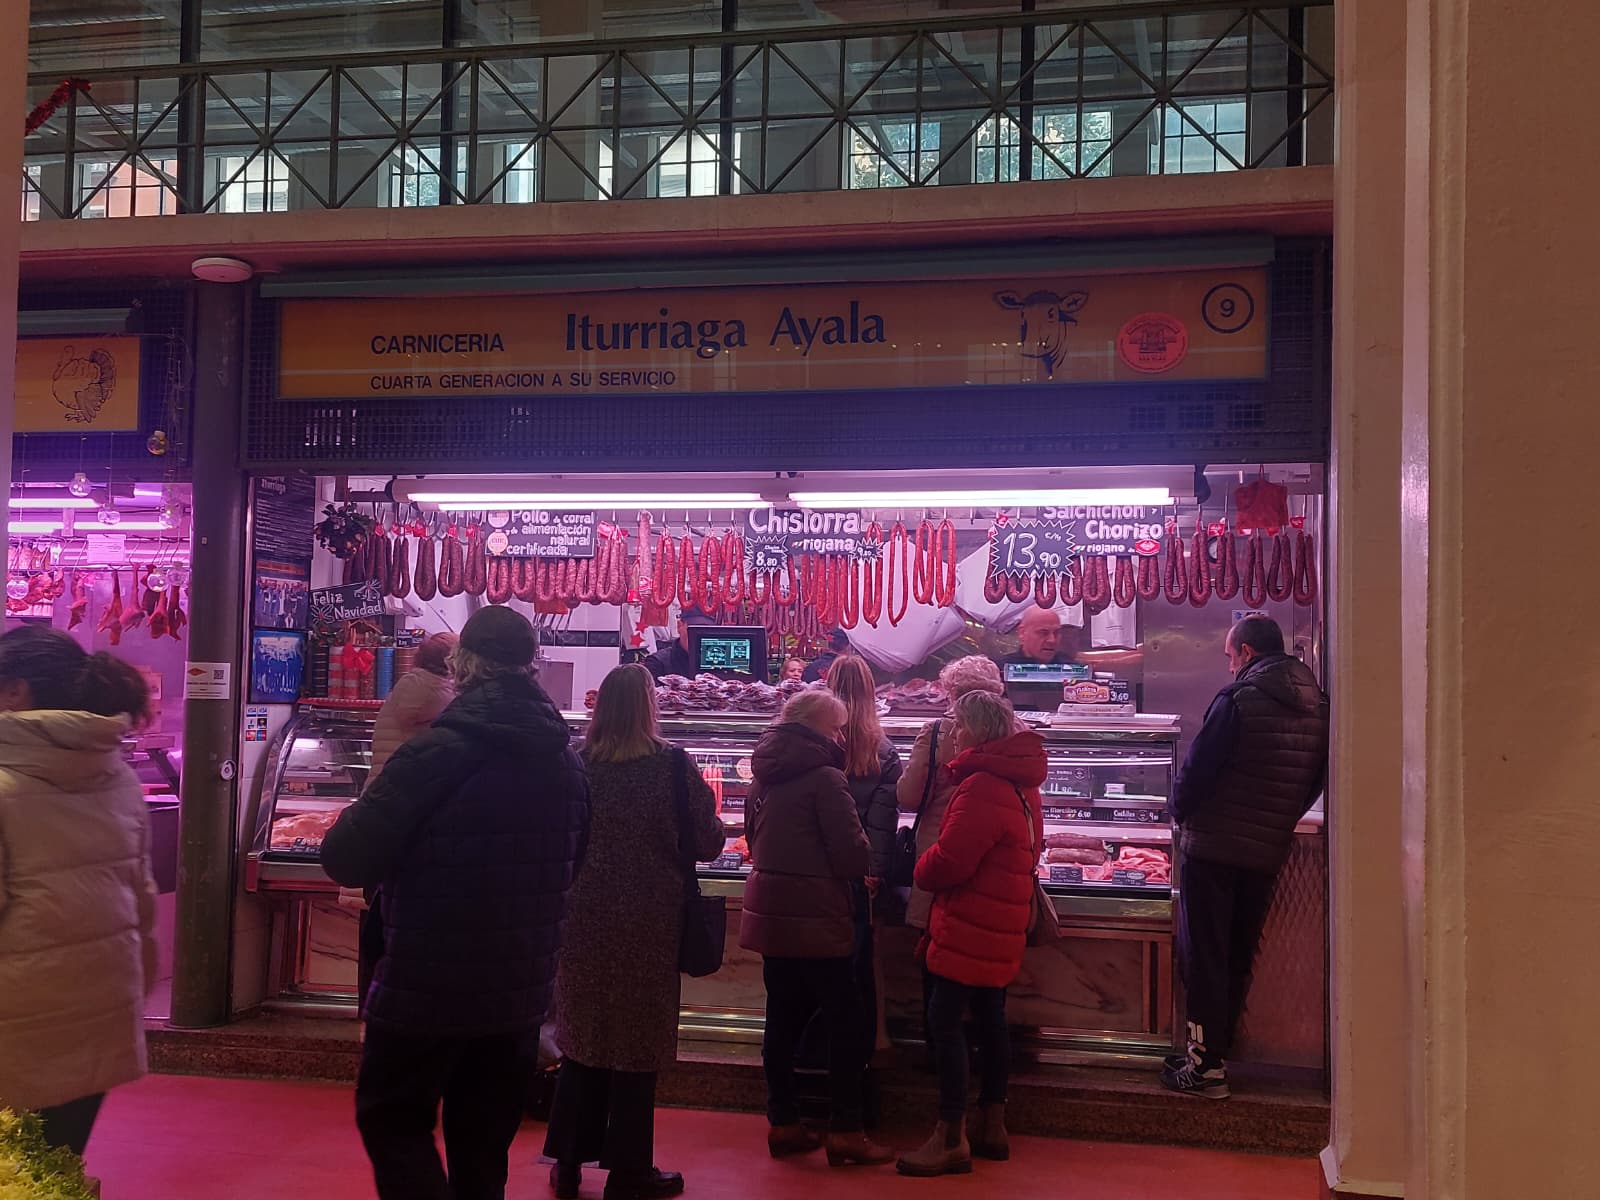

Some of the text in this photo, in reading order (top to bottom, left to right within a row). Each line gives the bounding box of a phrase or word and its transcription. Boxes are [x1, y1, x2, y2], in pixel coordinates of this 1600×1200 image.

[1219, 298, 1236, 318] 9
[565, 300, 887, 360] Iturriaga Ayala
[370, 333, 505, 355] CARNICERIA
[370, 370, 676, 391] CUARTA GENERACION A SU SERVICIO
[511, 510, 550, 524] Pollo
[562, 511, 595, 524] corral
[748, 507, 861, 535] Chistorra
[1084, 519, 1164, 540] Chorizo
[549, 535, 591, 546] natural
[803, 538, 857, 554] riojana
[1086, 543, 1126, 556] riojano
[312, 591, 345, 606] Feliz
[334, 600, 383, 619] Navidad
